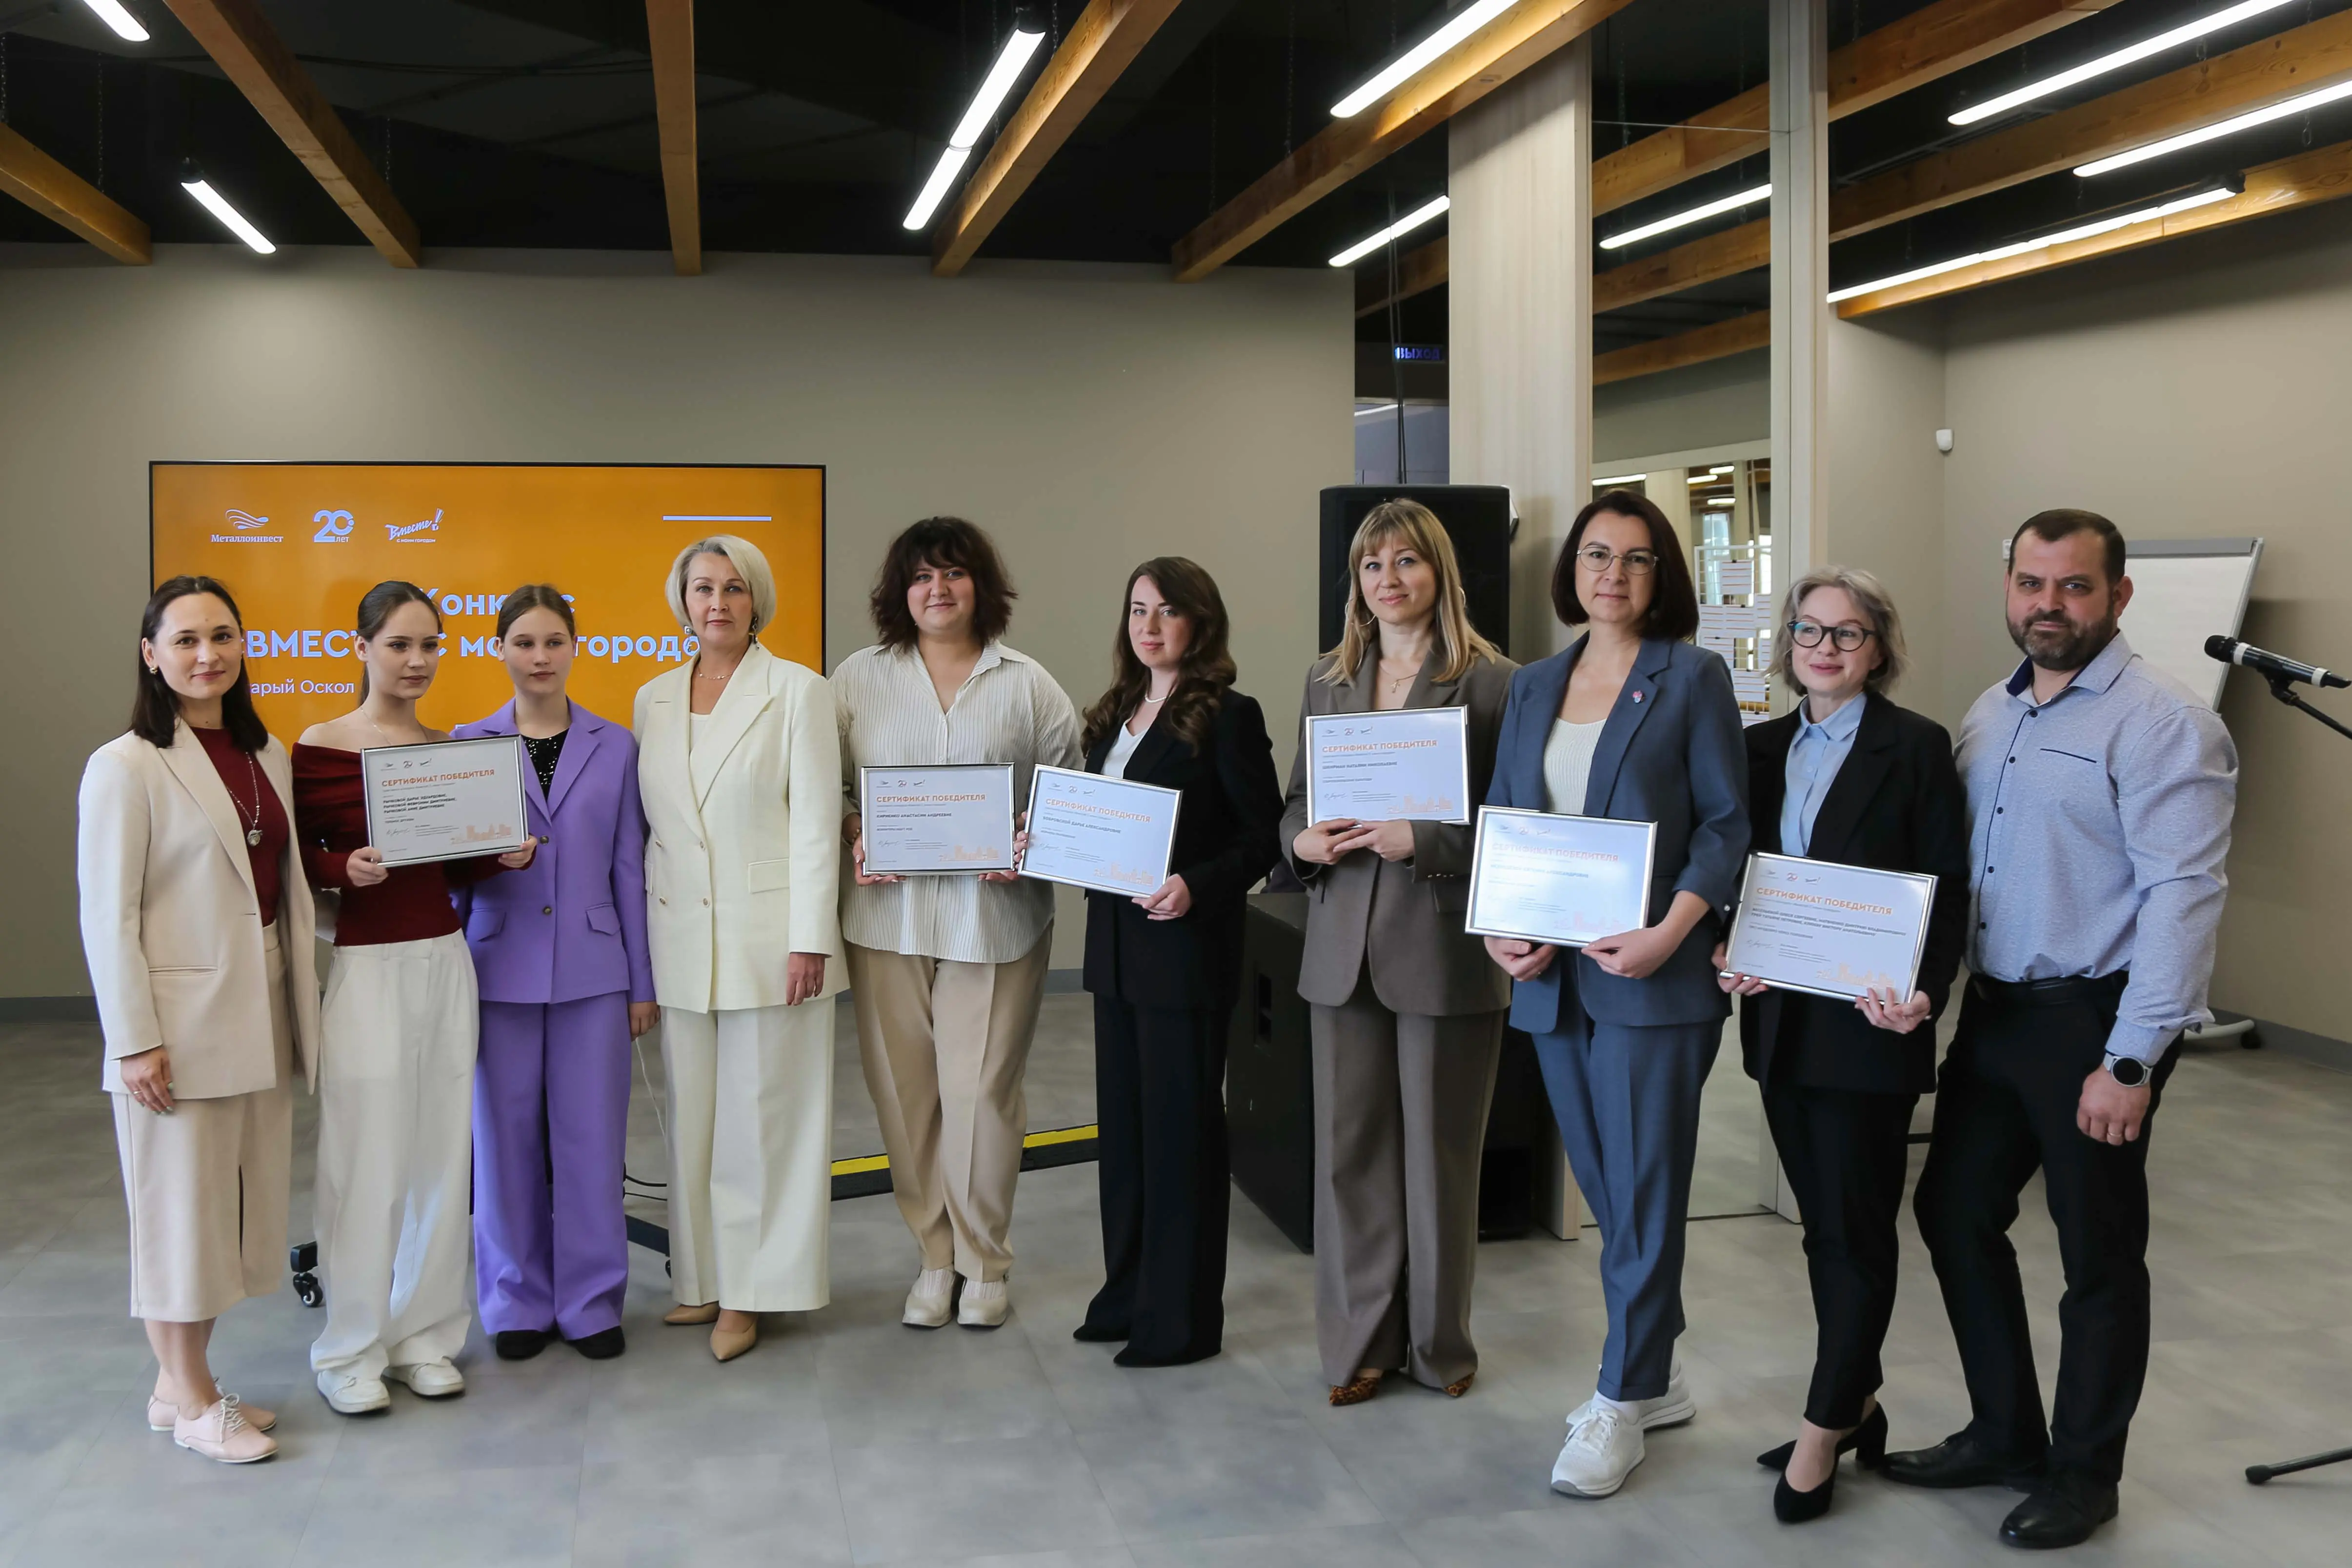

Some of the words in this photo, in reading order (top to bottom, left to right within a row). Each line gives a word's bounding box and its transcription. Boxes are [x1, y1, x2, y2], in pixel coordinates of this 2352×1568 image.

[1395, 347, 1440, 360] ВЫХОД
[313, 509, 355, 543] 20
[211, 534, 283, 543] Металлоинвест
[250, 678, 295, 697] арый
[300, 680, 355, 694] Оскол
[1323, 743, 1378, 753] СЕРТИФИКАТ
[1380, 740, 1437, 750] ПОБЕДИТЕЛЯ
[382, 775, 438, 787] СЕРТИФИКАТ
[441, 769, 495, 781] ПОБЕДИТЕЛЯ
[1045, 798, 1097, 813] СЕРТИФИКАТ
[1099, 807, 1151, 823] ПОБЕДИТЕЛЯ
[1556, 849, 1619, 862] ПОБЕДИТЕЛЯ
[1756, 887, 1823, 904] СЕРТИФИКАТ
[1825, 898, 1892, 916] ПОБЕДИТЕЛЯ
